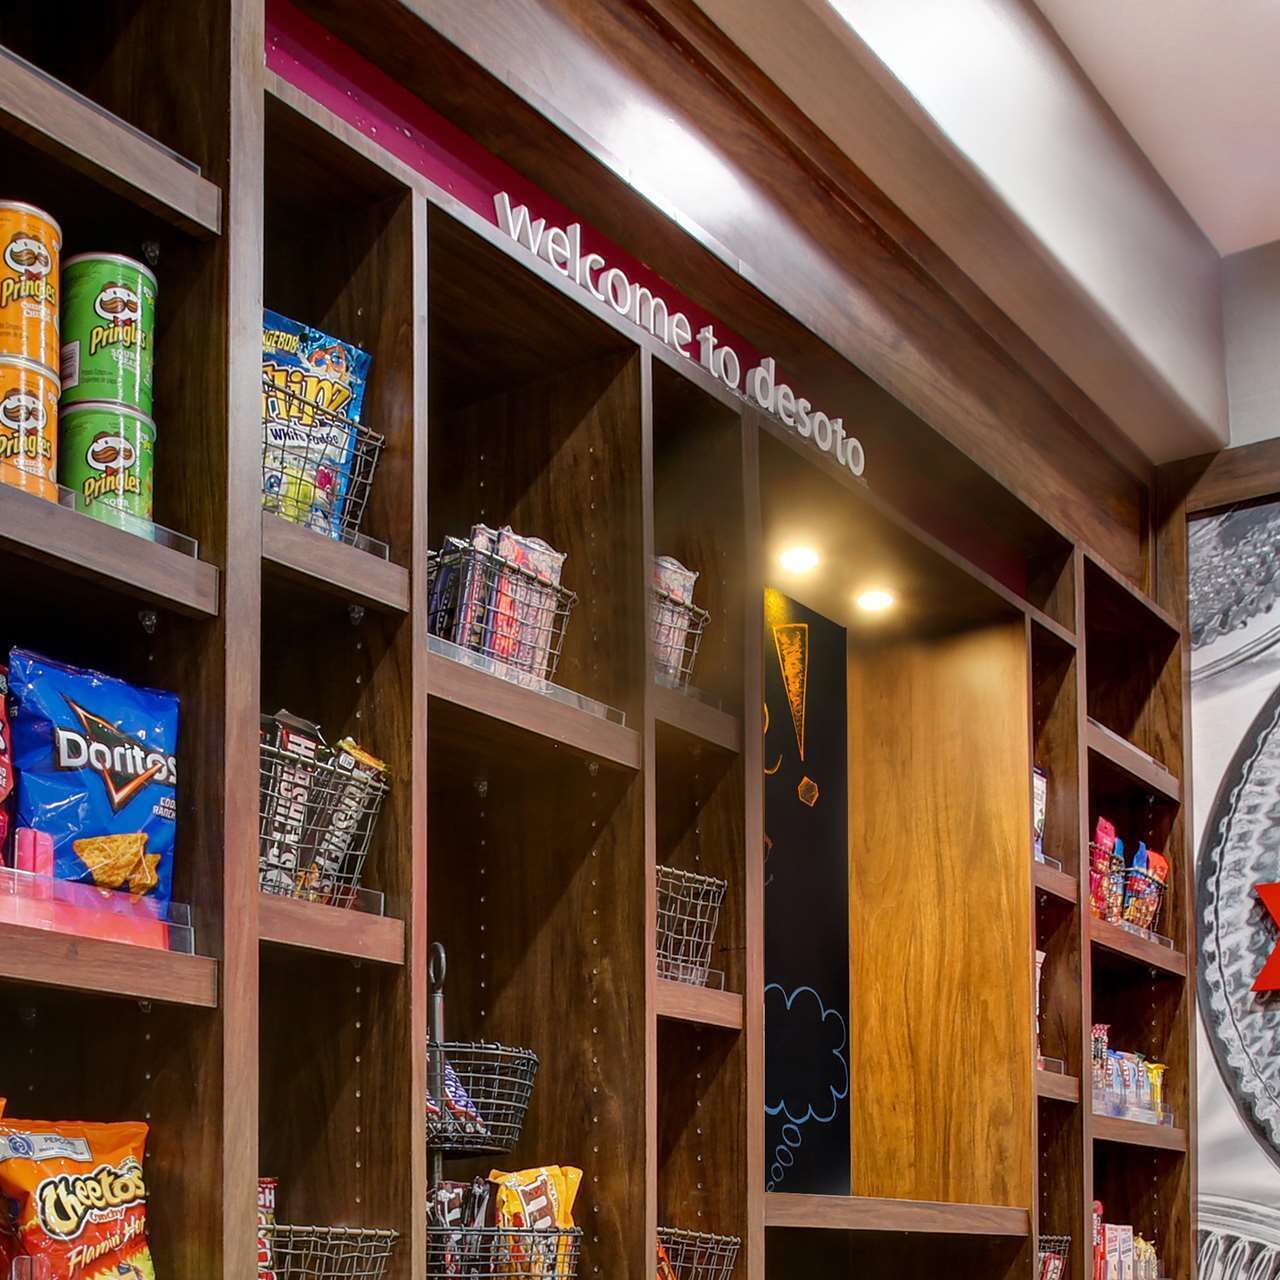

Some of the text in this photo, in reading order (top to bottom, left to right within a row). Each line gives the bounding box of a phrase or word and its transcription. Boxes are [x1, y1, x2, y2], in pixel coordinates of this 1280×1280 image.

[1, 274, 57, 306] Pringles
[89, 321, 147, 356] Pringls
[493, 191, 866, 477] welcome to desoto
[84, 469, 141, 507] Pringles
[58, 727, 177, 785] Doritos
[42, 1168, 145, 1234] Cheetos
